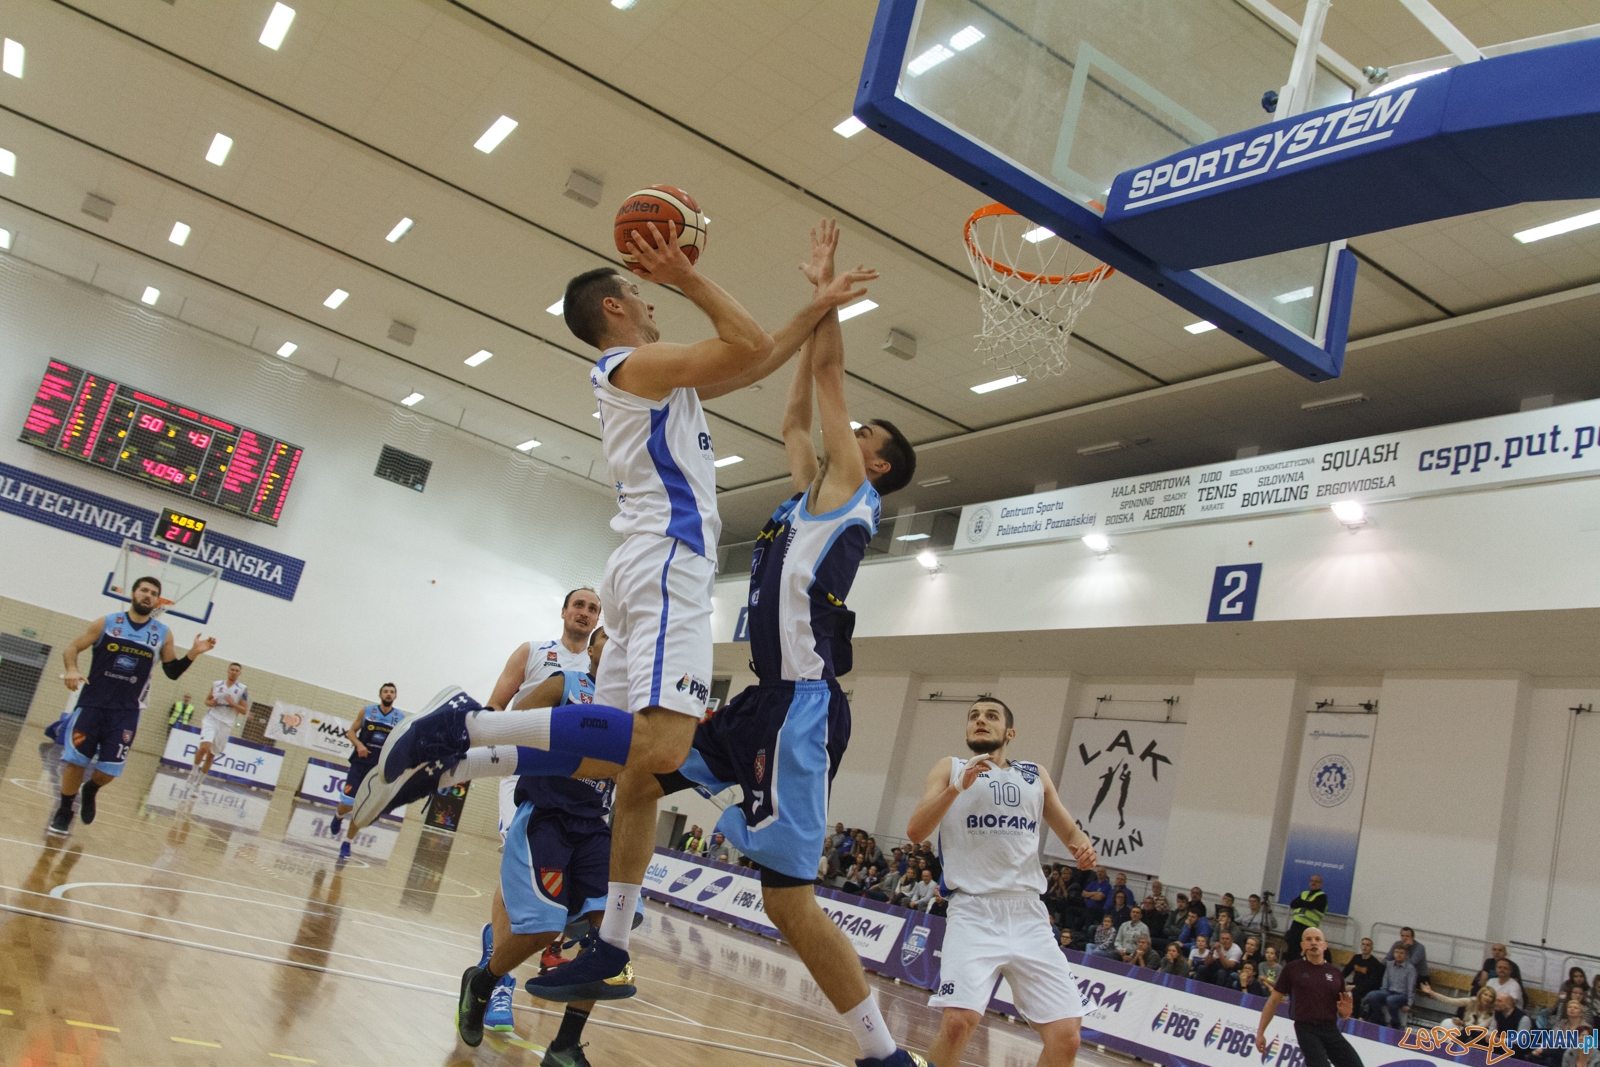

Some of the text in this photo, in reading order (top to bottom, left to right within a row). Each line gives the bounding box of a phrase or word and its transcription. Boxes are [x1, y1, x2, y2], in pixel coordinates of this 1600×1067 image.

[138, 414, 165, 432] 50
[188, 431, 211, 449] 43
[1418, 424, 1600, 475] cspp.put.p
[1111, 485, 1136, 498] HALA
[1138, 475, 1191, 494] SPORTOWA
[1199, 471, 1222, 484] JUDO
[1321, 442, 1400, 471] SQUASH
[1198, 483, 1238, 502] TENIS
[1257, 471, 1305, 487] SIŁOWNIA
[1001, 501, 1064, 519] Centrum Sportu
[1105, 475, 1396, 525] BOISKA AEROBIK KARATE BOWLING ERGOWIOSŁA
[165, 526, 192, 543] 21
[996, 513, 1097, 536] Politechniki Poznańskiej
[1219, 570, 1248, 615] 2
[146, 631, 159, 647] 13
[116, 743, 130, 760] 13
[1079, 730, 1173, 782] LAK
[989, 781, 1020, 807] 10
[966, 814, 1036, 833] BIOFARM
[646, 864, 668, 878] club
[1172, 1004, 1203, 1019] fundacja
[1163, 1011, 1200, 1041] PBG
[1217, 1027, 1257, 1058] PBG
